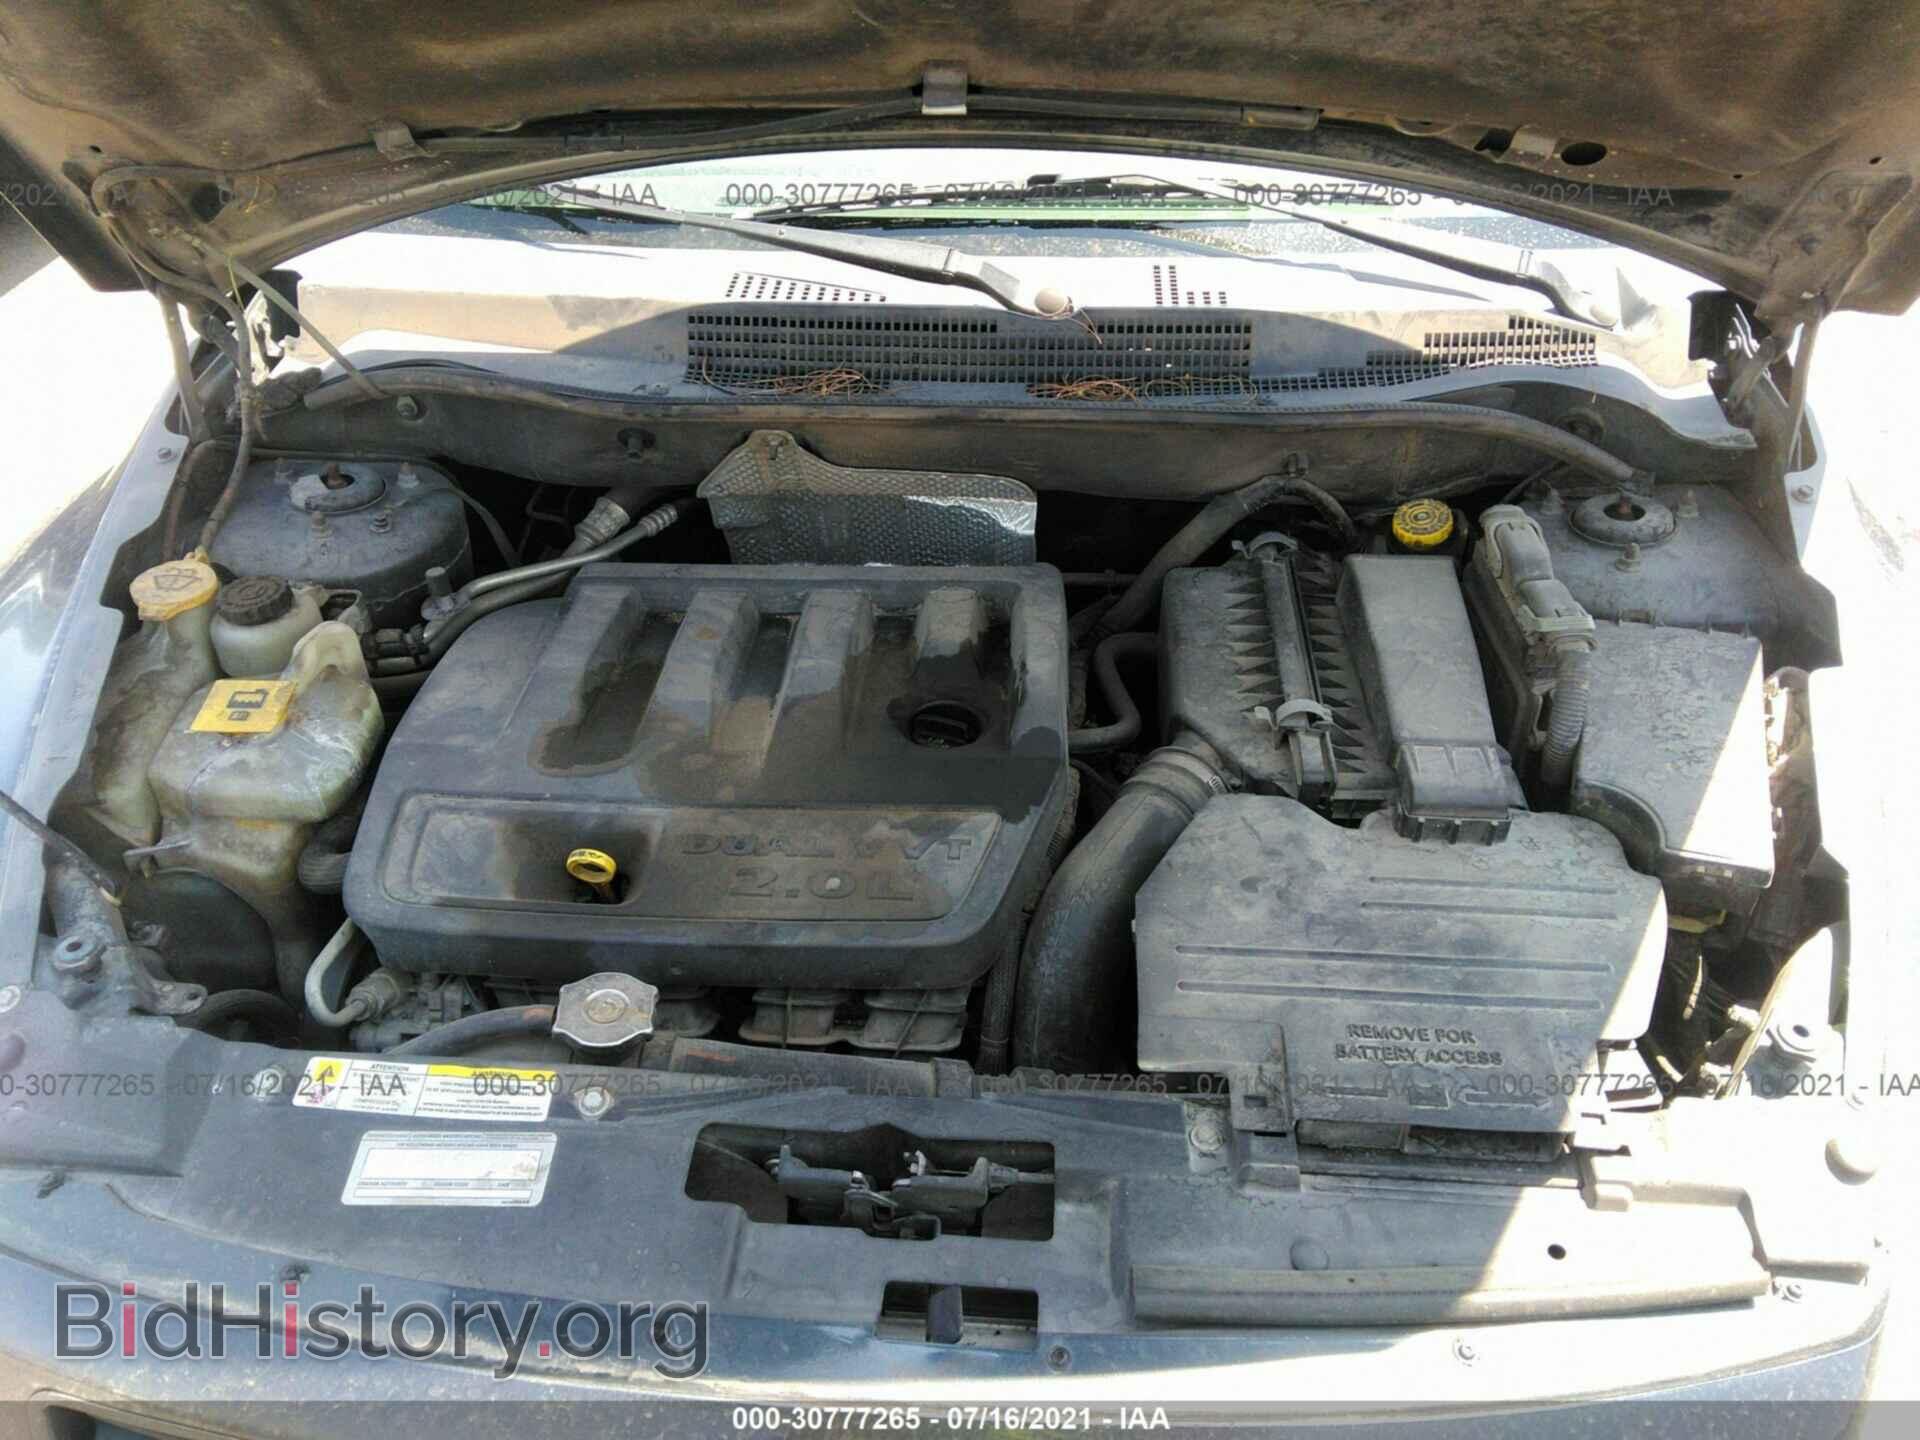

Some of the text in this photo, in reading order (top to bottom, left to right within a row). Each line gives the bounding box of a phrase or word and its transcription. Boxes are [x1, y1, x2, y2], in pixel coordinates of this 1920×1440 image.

[1347, 1023, 1476, 1044] REMOVE FOR
[1335, 1043, 1502, 1066] BATTERY ACCESS
